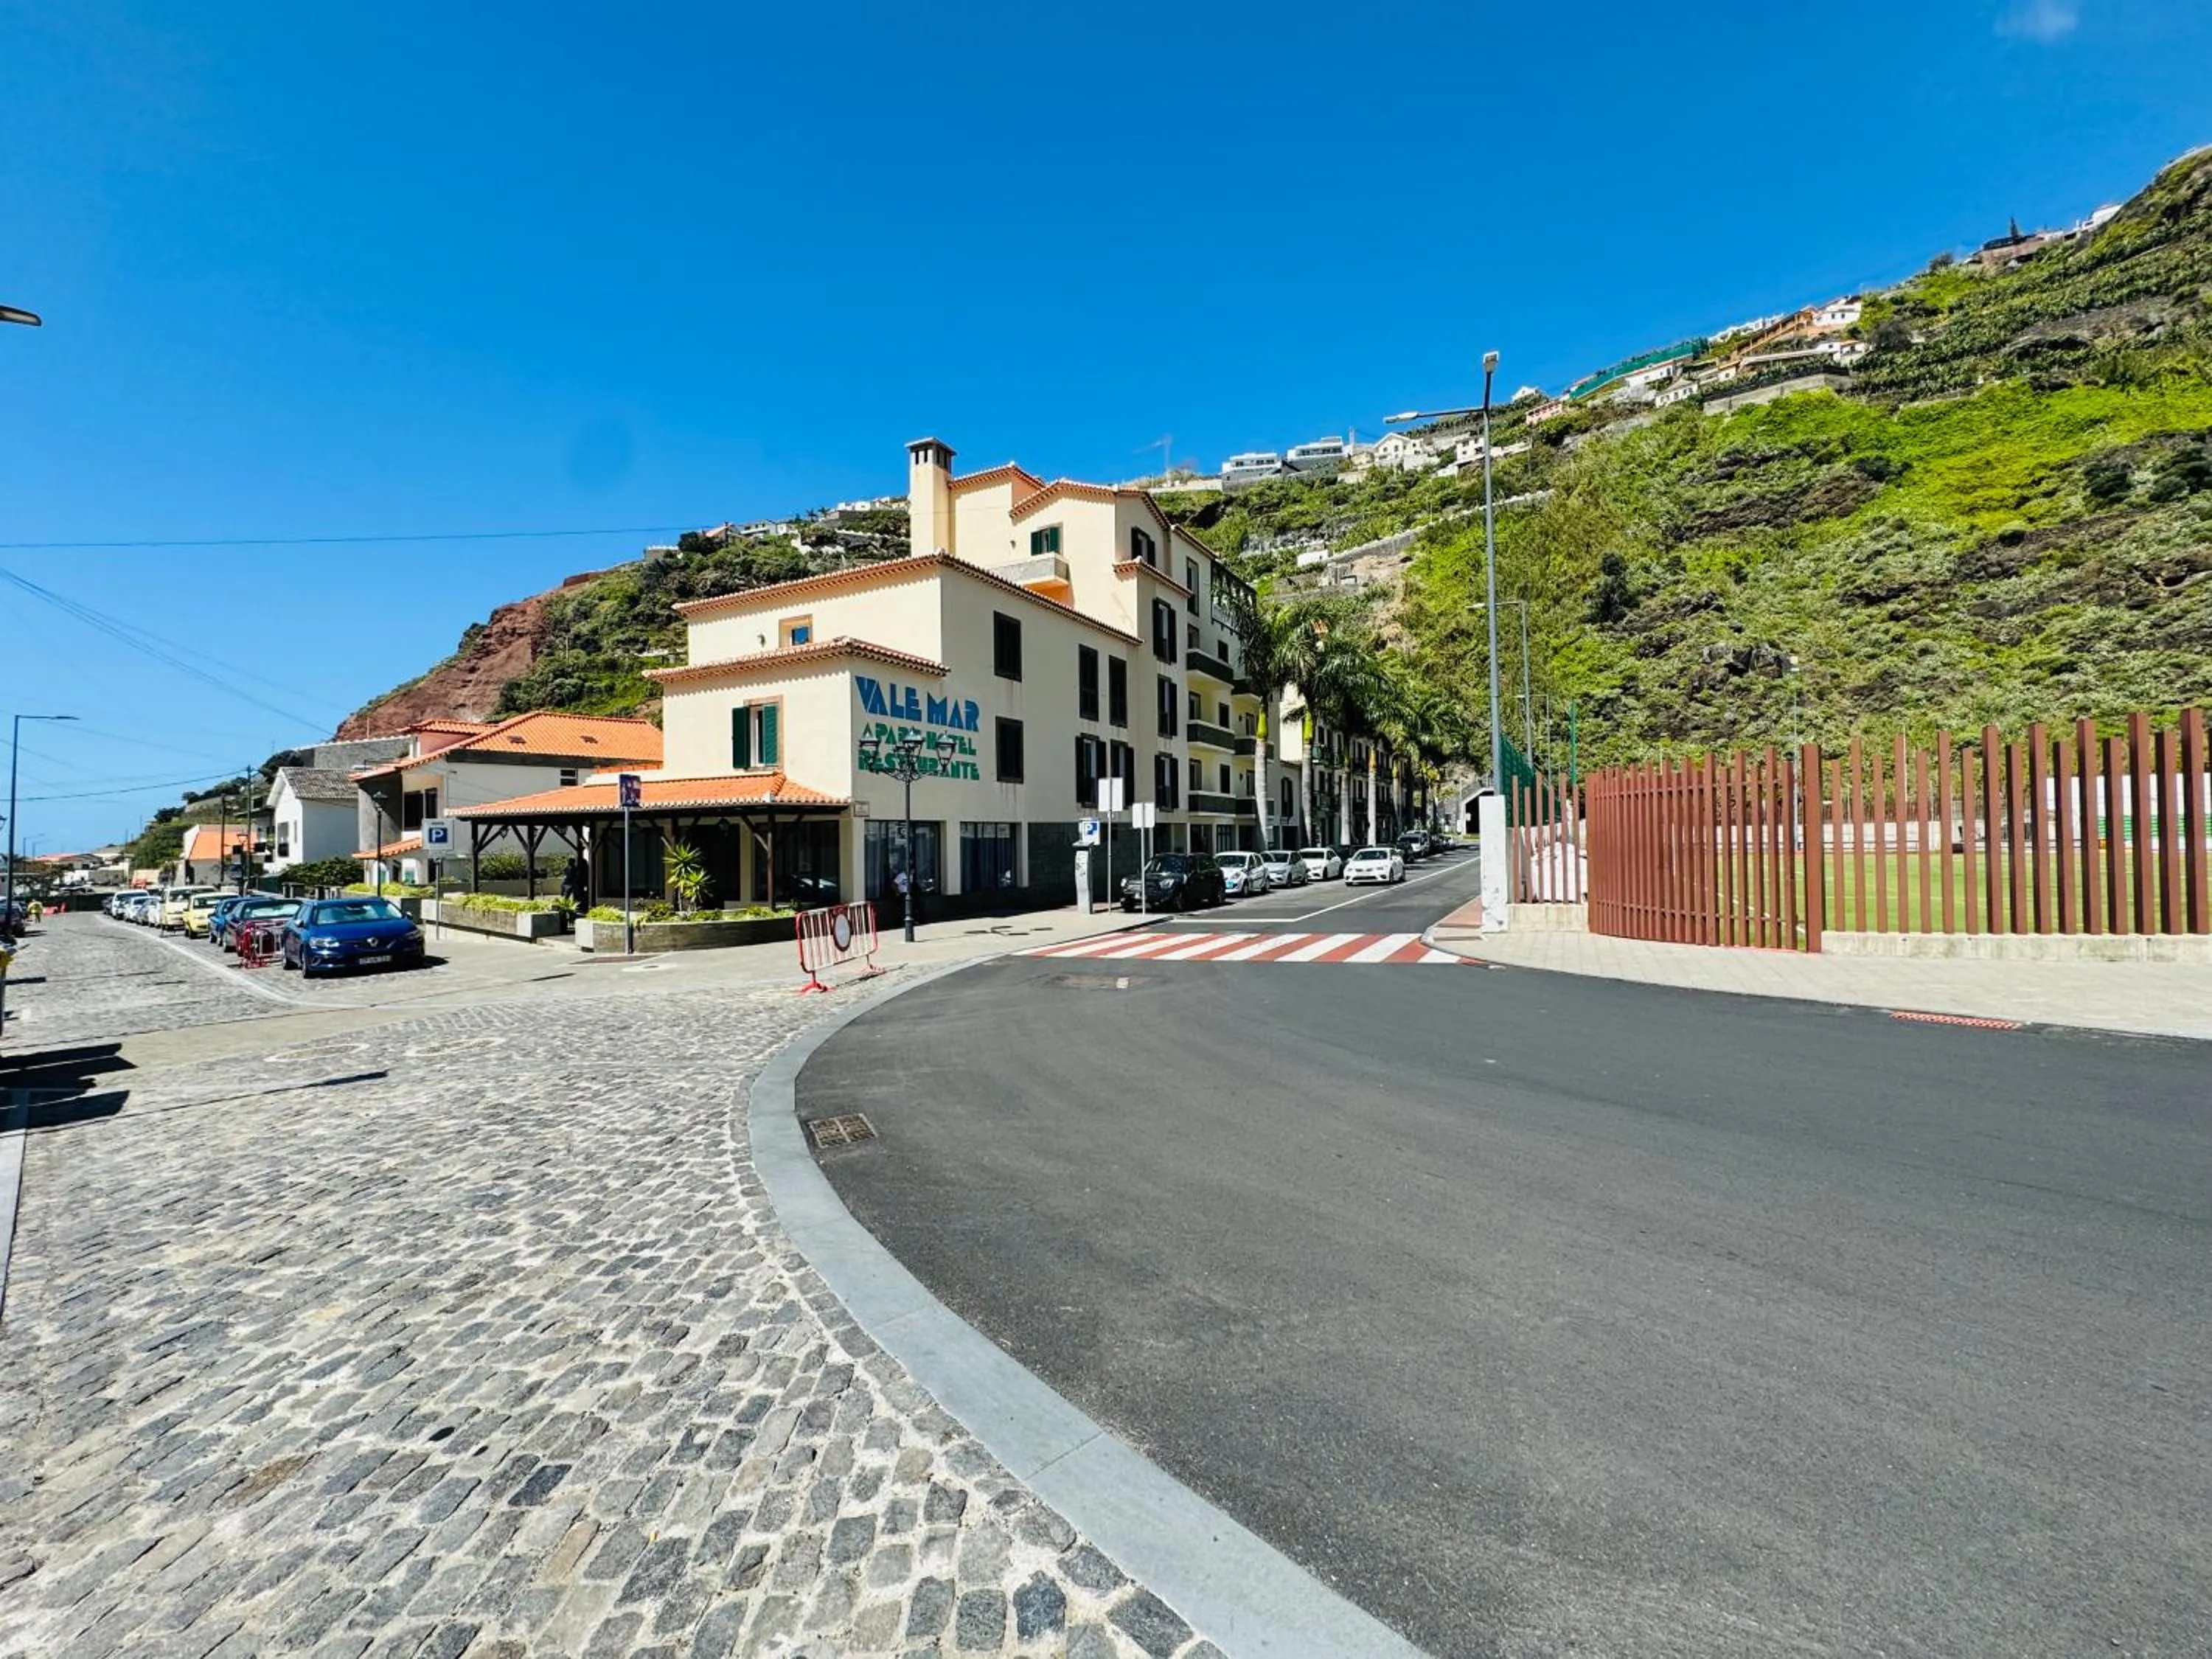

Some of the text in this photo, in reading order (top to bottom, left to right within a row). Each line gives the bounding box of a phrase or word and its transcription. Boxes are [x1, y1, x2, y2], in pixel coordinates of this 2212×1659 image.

[855, 675, 979, 732] VALE MAR
[858, 749, 980, 780] RESTURANTE
[431, 828, 444, 842] P
